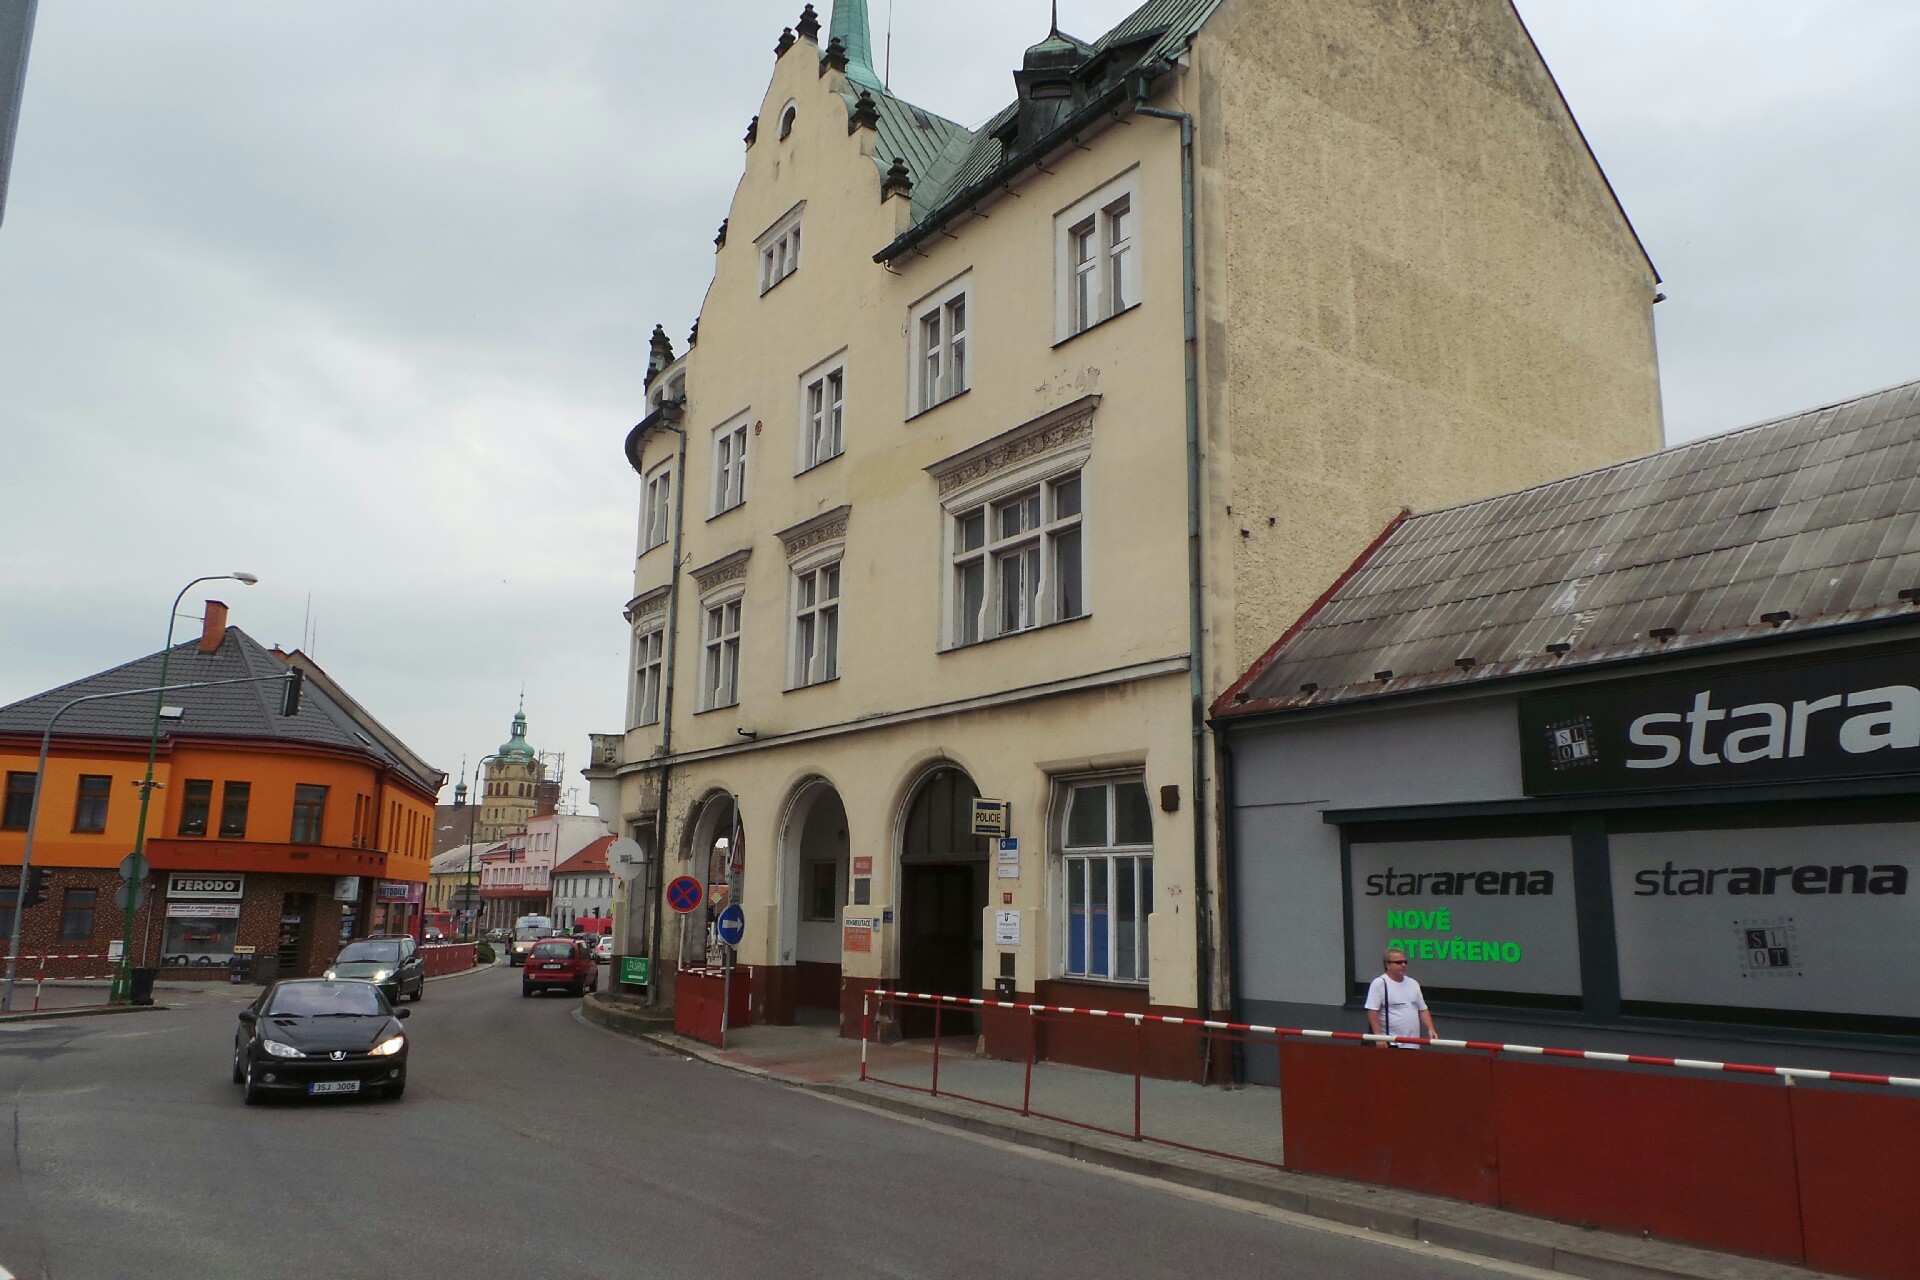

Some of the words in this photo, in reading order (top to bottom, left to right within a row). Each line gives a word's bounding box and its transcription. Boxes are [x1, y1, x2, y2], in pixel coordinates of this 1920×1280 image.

[1625, 685, 1920, 769] stara
[975, 812, 1001, 823] POLICIE
[177, 879, 235, 891] FERODO
[1365, 867, 1554, 896] stararena
[1634, 861, 1909, 896] stararena
[316, 1083, 330, 1091] 3SJ
